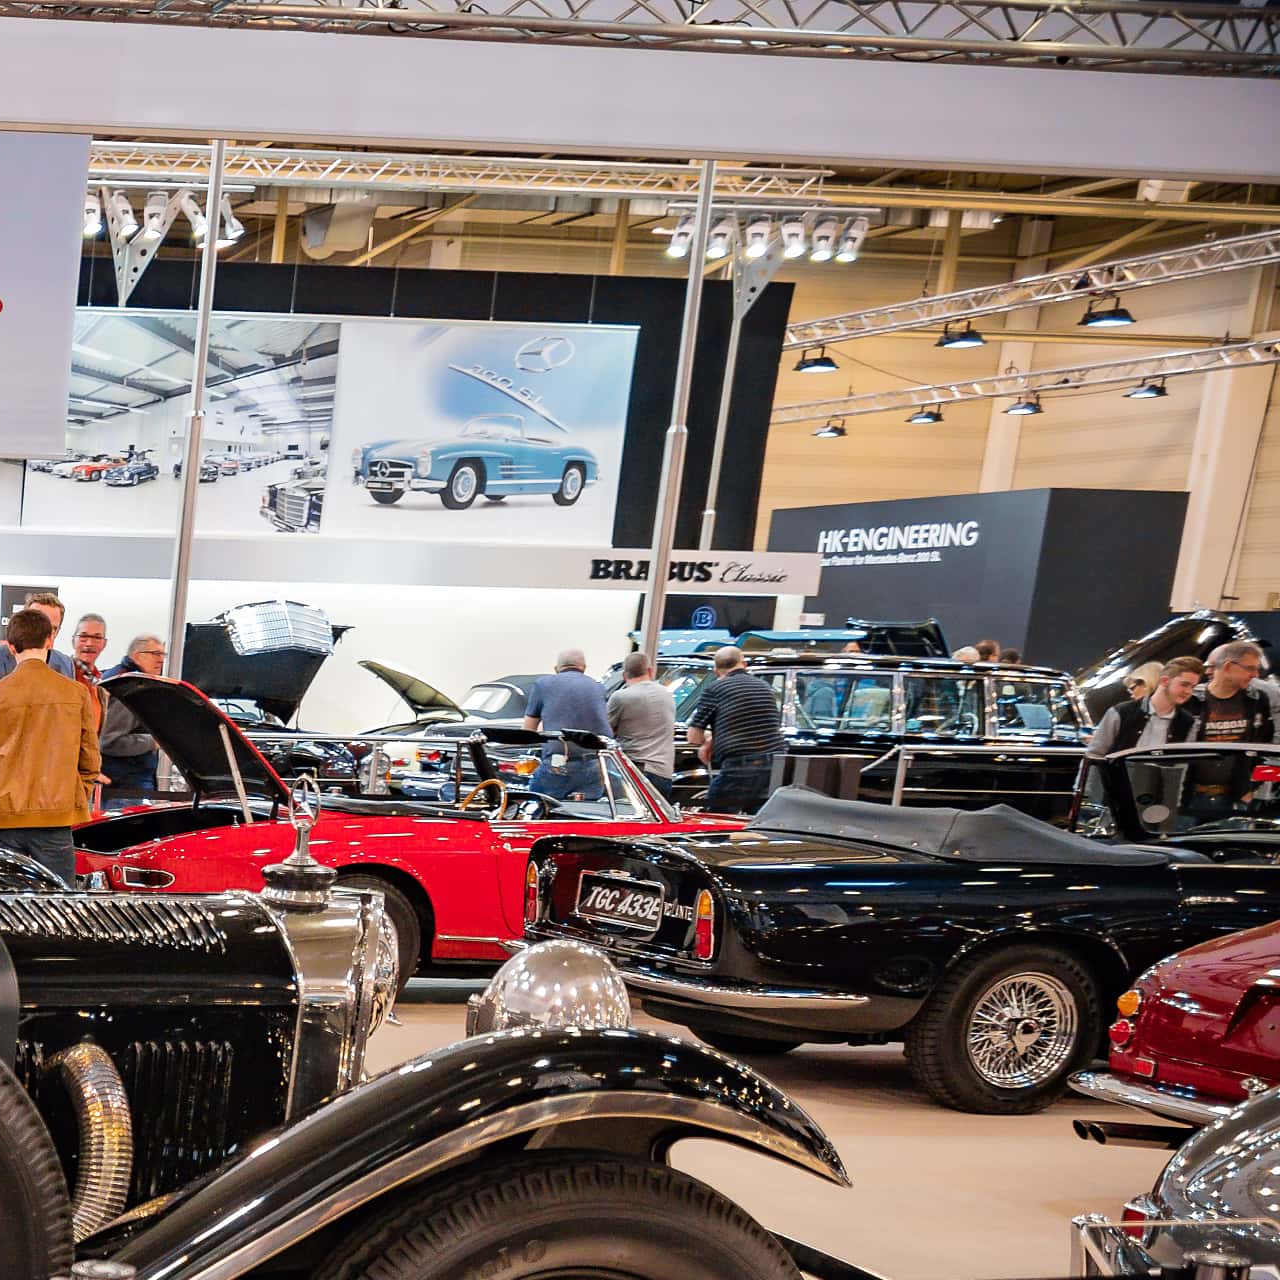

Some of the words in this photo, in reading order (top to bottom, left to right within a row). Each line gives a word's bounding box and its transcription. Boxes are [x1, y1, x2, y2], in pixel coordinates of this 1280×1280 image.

[817, 520, 979, 553] HK-ENGINEERING
[719, 561, 790, 584] Classic
[587, 886, 620, 911] TGC
[617, 892, 662, 921] 433E
